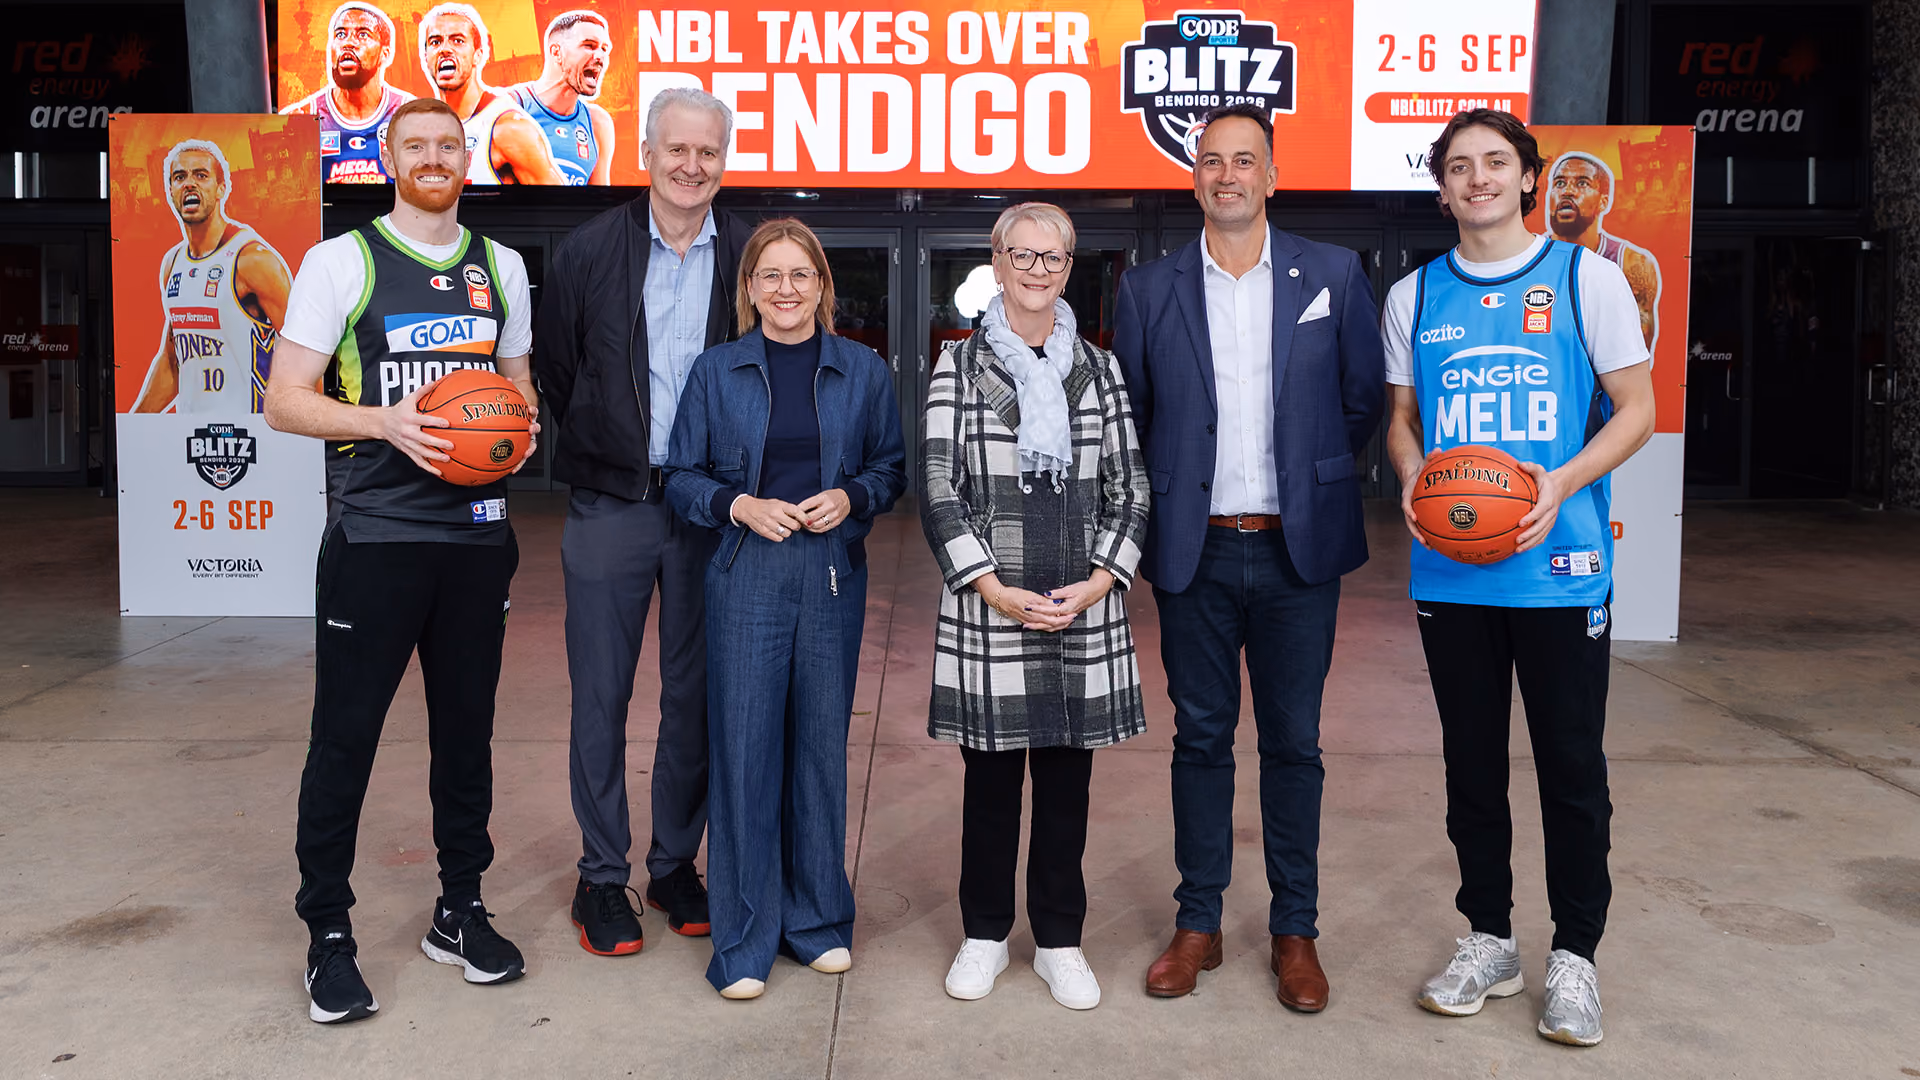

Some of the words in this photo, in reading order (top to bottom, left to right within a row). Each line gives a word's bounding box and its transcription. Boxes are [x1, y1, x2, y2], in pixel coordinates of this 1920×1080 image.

[638, 10, 742, 63] NBL
[758, 10, 929, 65] TAKES
[946, 10, 1090, 65] OVER
[1182, 19, 1239, 37] CODE
[11, 33, 94, 73] red
[1378, 34, 1436, 72] 2-6
[1461, 34, 1527, 72] SEP
[1678, 35, 1764, 75] red
[1134, 47, 1283, 94] BLITZ
[29, 78, 110, 100] energy
[1696, 80, 1776, 103] energy
[1155, 95, 1220, 107] BENDIGO
[1696, 108, 1804, 132] arena
[330, 160, 379, 178] MEGA
[468, 271, 485, 284] NBL
[1529, 292, 1549, 304] NBL
[2, 332, 26, 345] red
[411, 317, 477, 348] GOAT
[1420, 324, 1465, 344] ozito
[38, 343, 69, 352] arena
[1700, 352, 1732, 361] arena
[203, 368, 224, 392] 10
[1435, 391, 1558, 445] MELB
[210, 425, 234, 434] CODE
[190, 437, 252, 458] BLITZ
[494, 446, 509, 457] NBL
[1424, 468, 1512, 492] SPALDING
[173, 500, 214, 530] 2-6
[228, 500, 273, 530] SEP
[1453, 511, 1471, 523] NBL
